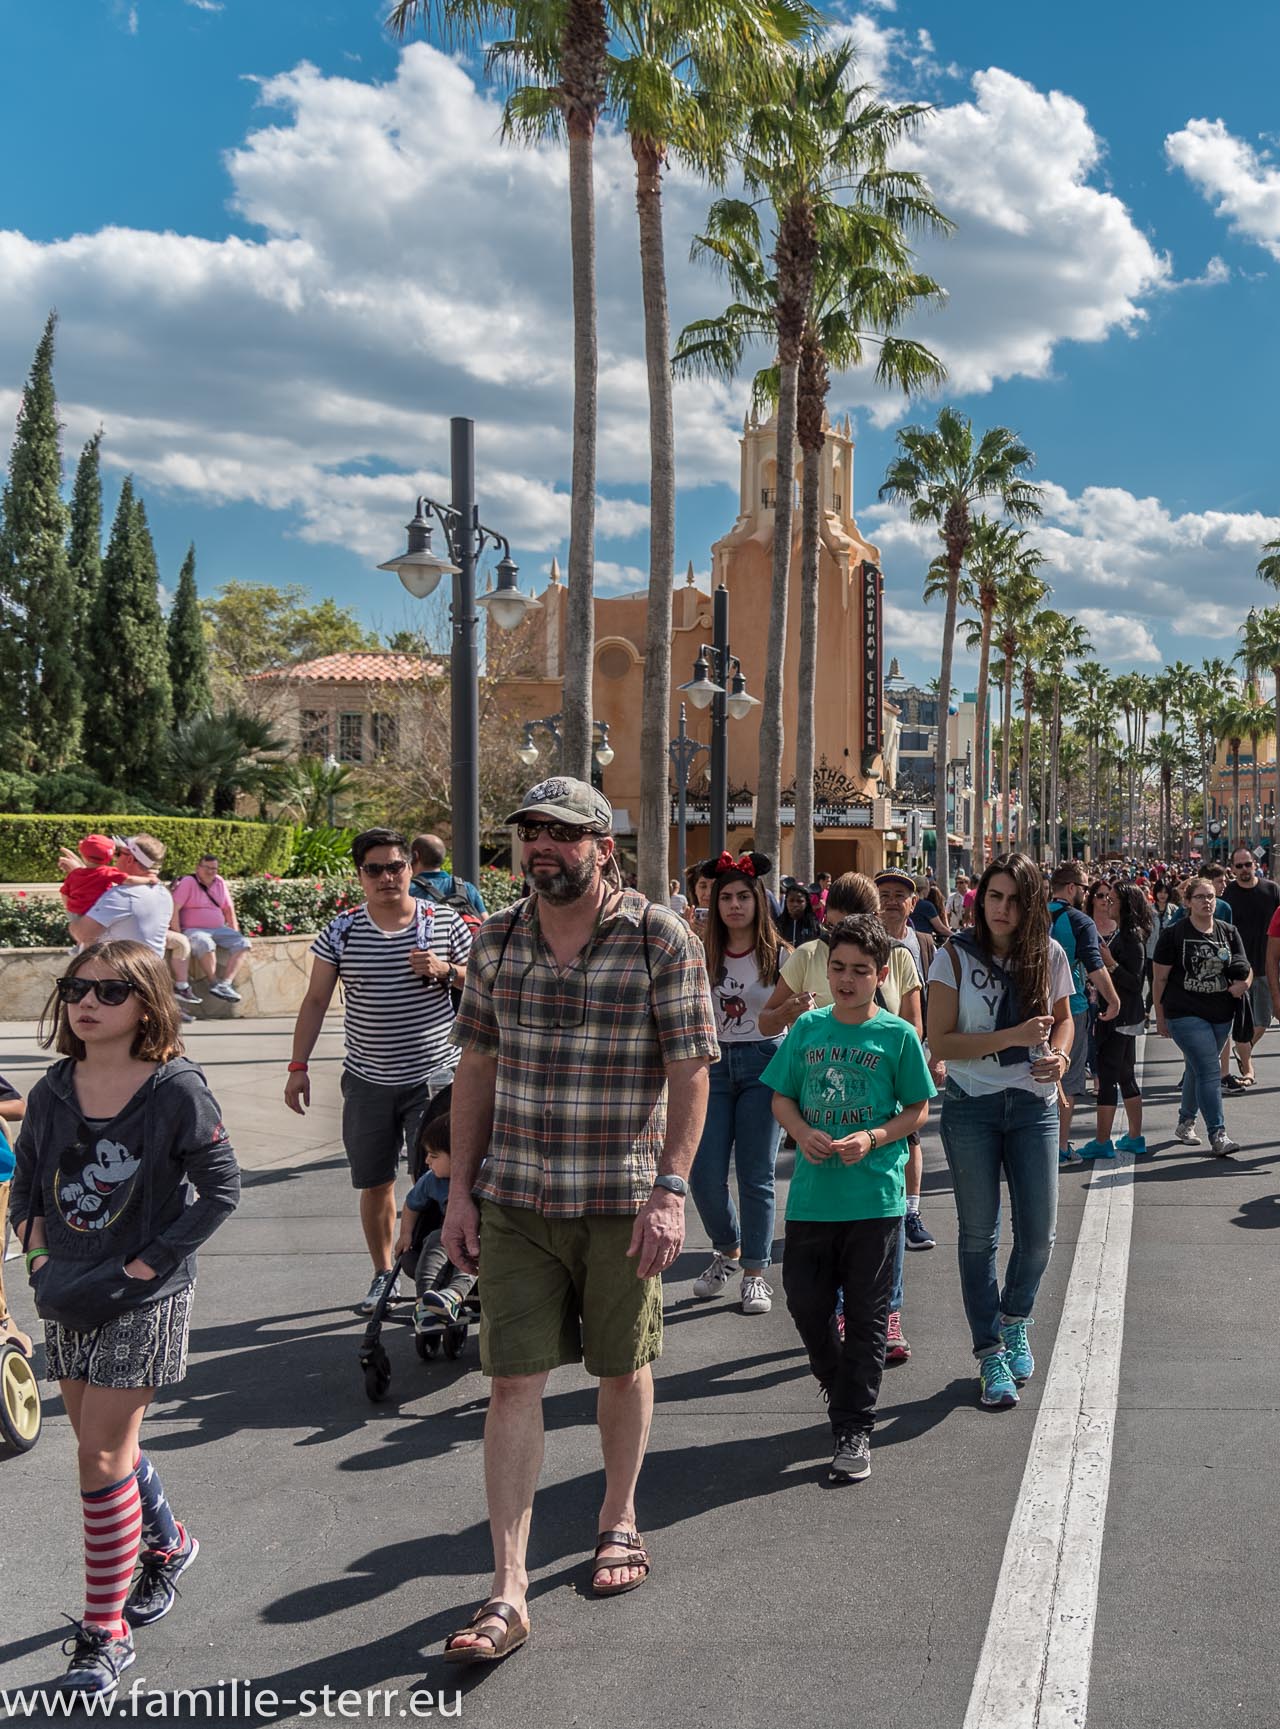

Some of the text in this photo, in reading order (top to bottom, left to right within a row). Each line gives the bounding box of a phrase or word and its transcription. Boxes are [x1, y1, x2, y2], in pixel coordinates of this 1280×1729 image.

[866, 571, 876, 746] CARTHAY CIRCLE
[793, 768, 855, 793] RTHAY
[813, 780, 842, 796] IRCLE
[829, 1046, 881, 1072] NATURE
[824, 1104, 874, 1126] PLANET
